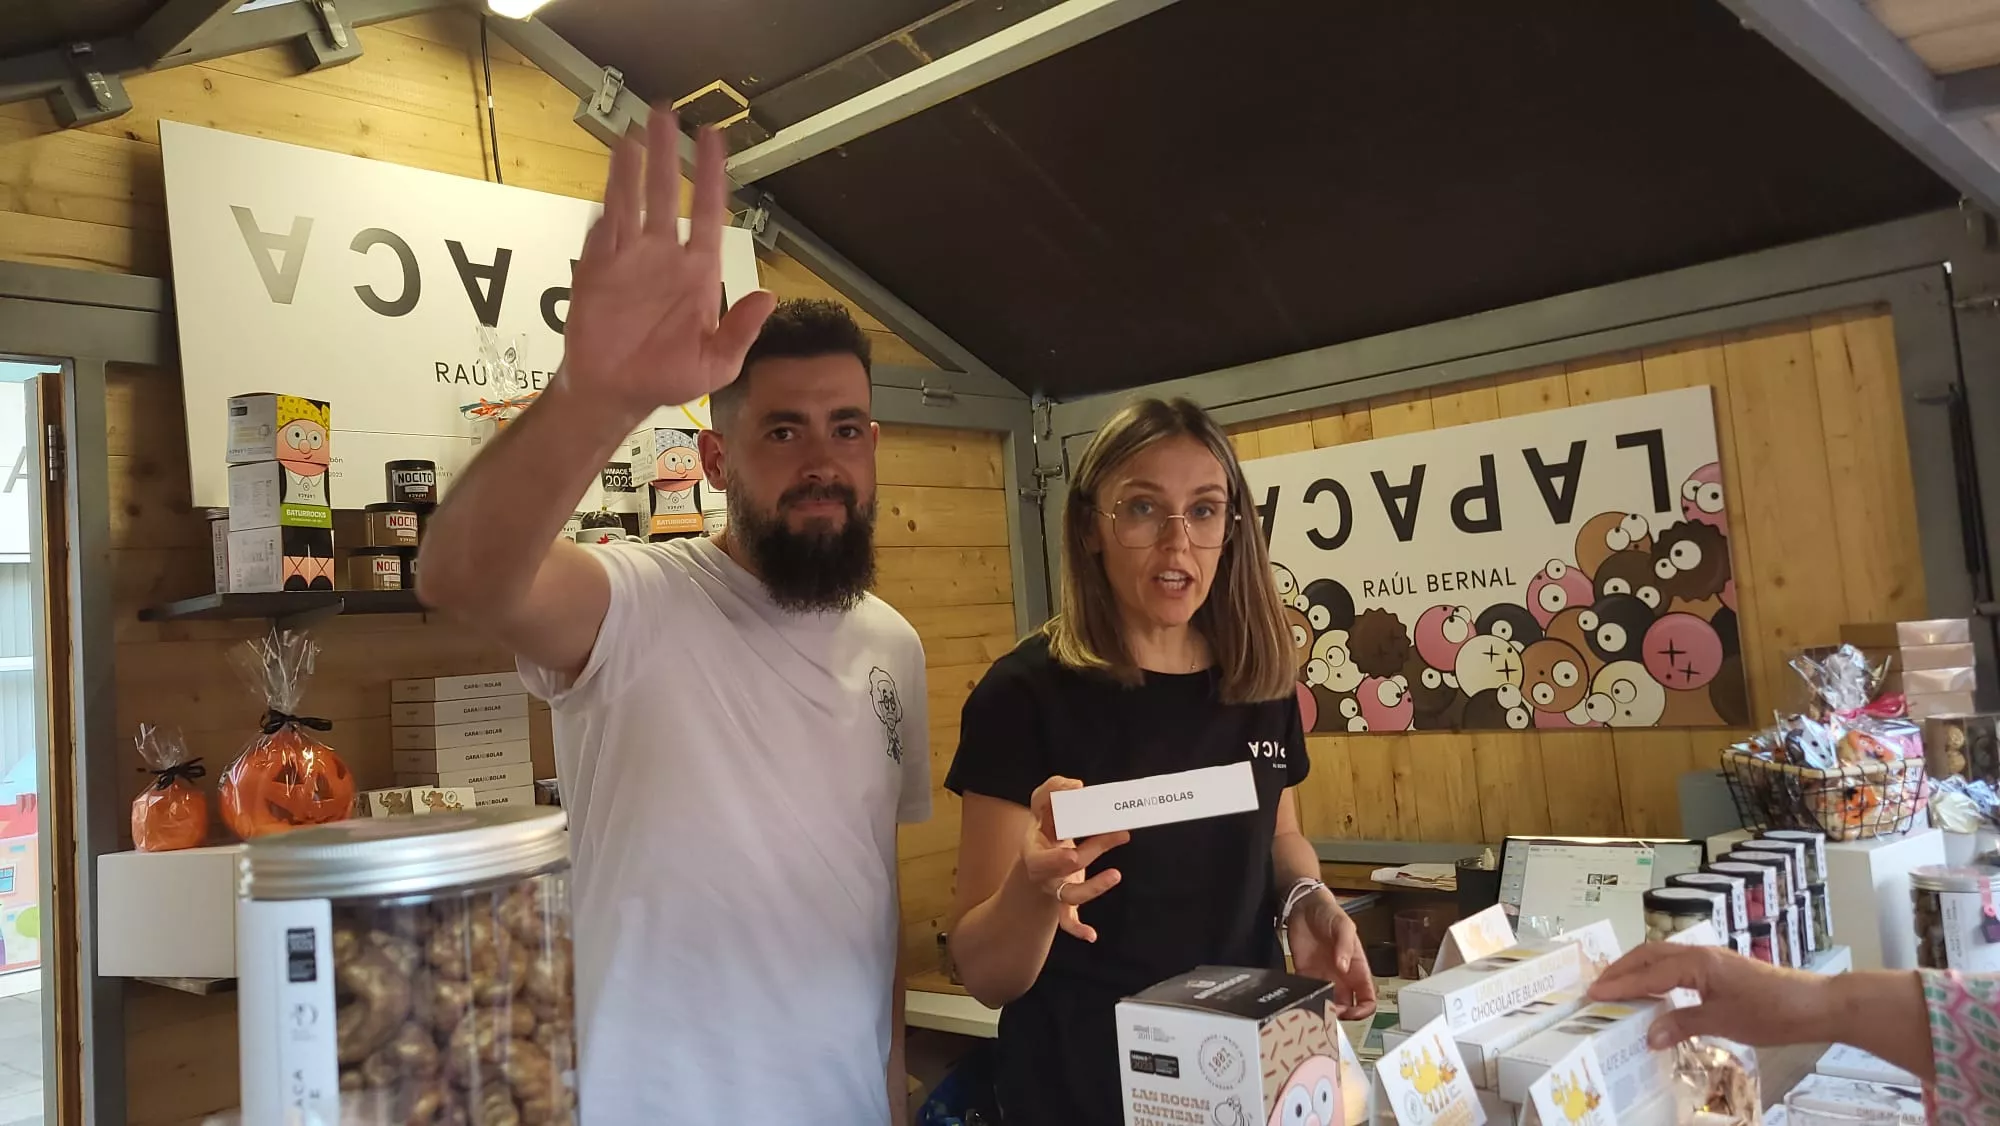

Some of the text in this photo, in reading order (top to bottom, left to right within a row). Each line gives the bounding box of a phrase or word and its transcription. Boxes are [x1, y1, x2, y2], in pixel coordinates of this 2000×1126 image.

[435, 360, 492, 387] RAÚ
[397, 472, 433, 484] NOCITO
[1363, 566, 1517, 598] RAÚL BERNAL
[1471, 973, 1555, 1024] CHOCOLATE BLANCO
